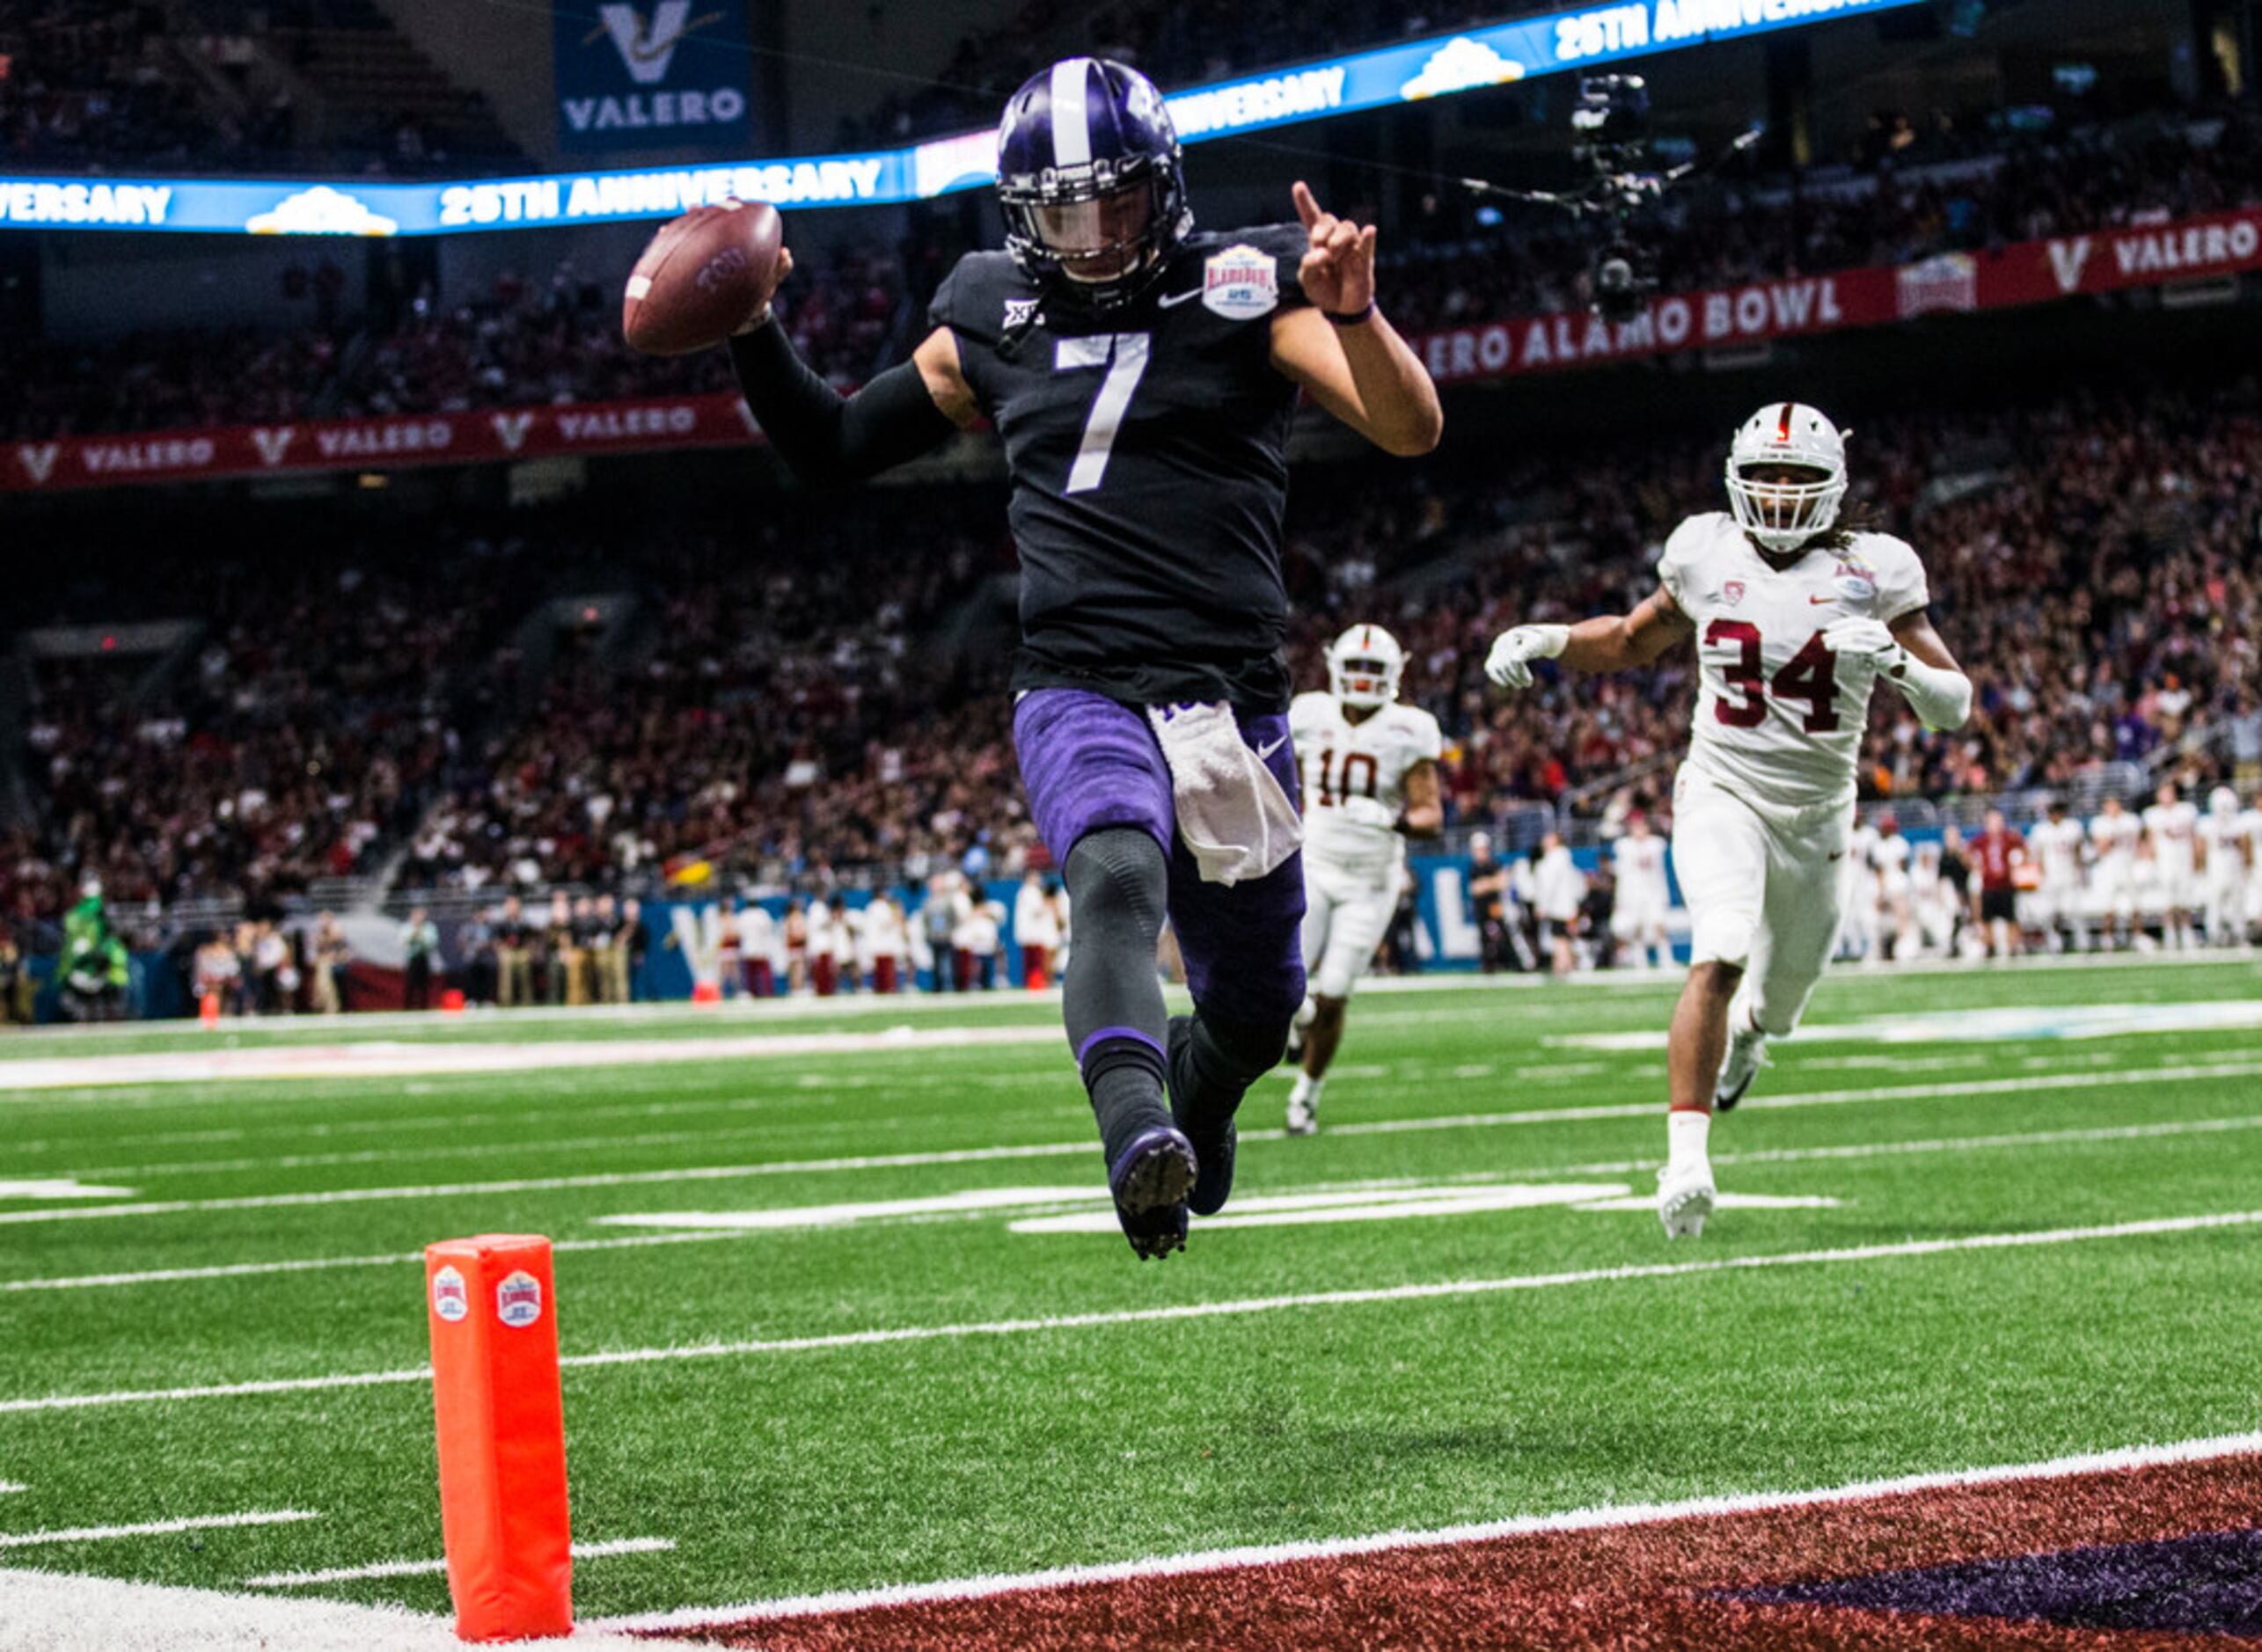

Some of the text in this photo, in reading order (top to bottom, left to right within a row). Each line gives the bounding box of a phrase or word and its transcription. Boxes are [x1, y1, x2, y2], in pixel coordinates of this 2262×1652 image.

[564, 88, 743, 129] VALERO
[567, 158, 881, 217] ANNIVERSARY
[2115, 219, 2259, 274] VALERO
[1424, 326, 1512, 379] ERO
[1523, 298, 1690, 365] ALAMO
[1705, 278, 1841, 338] BOWL
[83, 438, 214, 472] VALERO
[318, 421, 453, 456] VALERO
[557, 406, 696, 438] VALERO
[1055, 332, 1150, 496] 7
[1703, 618, 1841, 734] 34
[1319, 747, 1378, 808] 10
